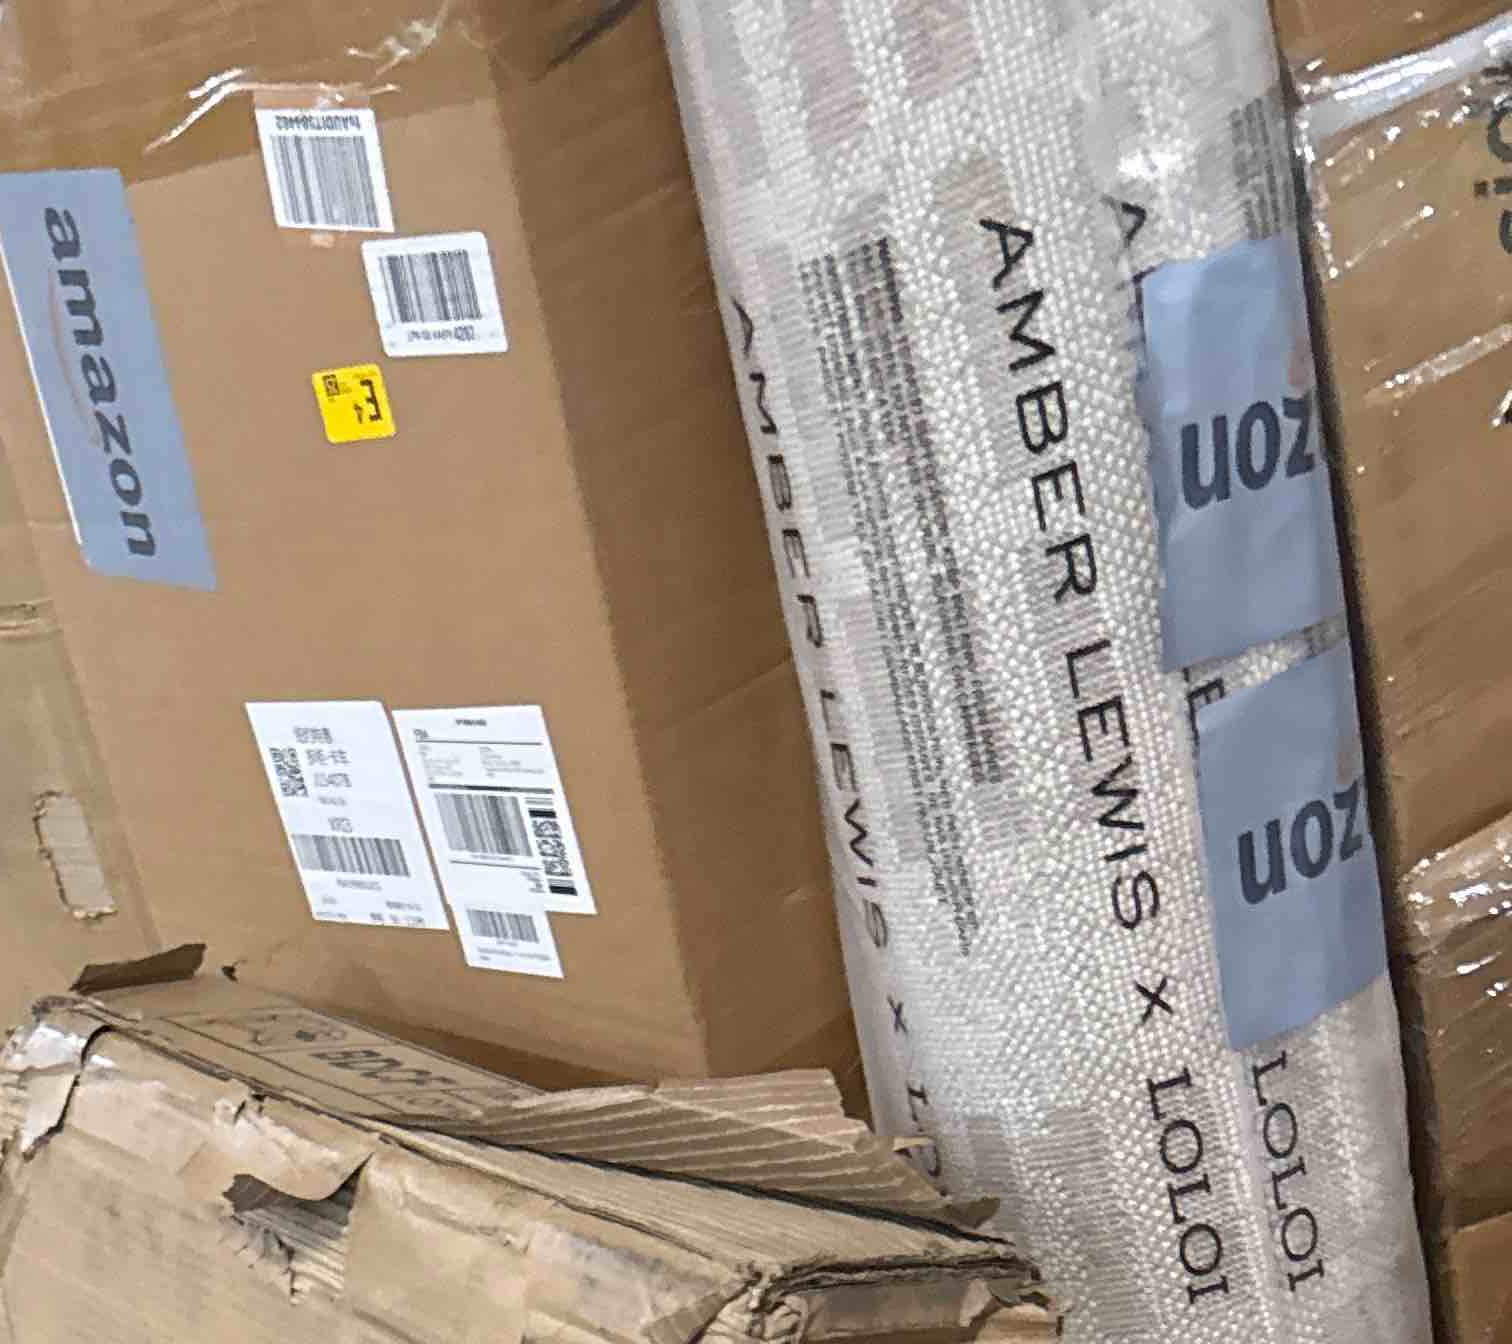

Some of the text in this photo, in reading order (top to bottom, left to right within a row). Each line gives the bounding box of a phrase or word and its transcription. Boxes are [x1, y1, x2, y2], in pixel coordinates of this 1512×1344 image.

[43, 204, 159, 559] amazon
[1181, 390, 1319, 508] zon
[733, 297, 825, 649] AMBER
[819, 688, 888, 948] LEWIS
[979, 216, 1099, 602] AMBER
[1065, 639, 1162, 931] LEWIS
[1146, 1065, 1229, 1305] LOLOI
[1236, 784, 1366, 906] zon
[1251, 1051, 1324, 1293] LOLOI
